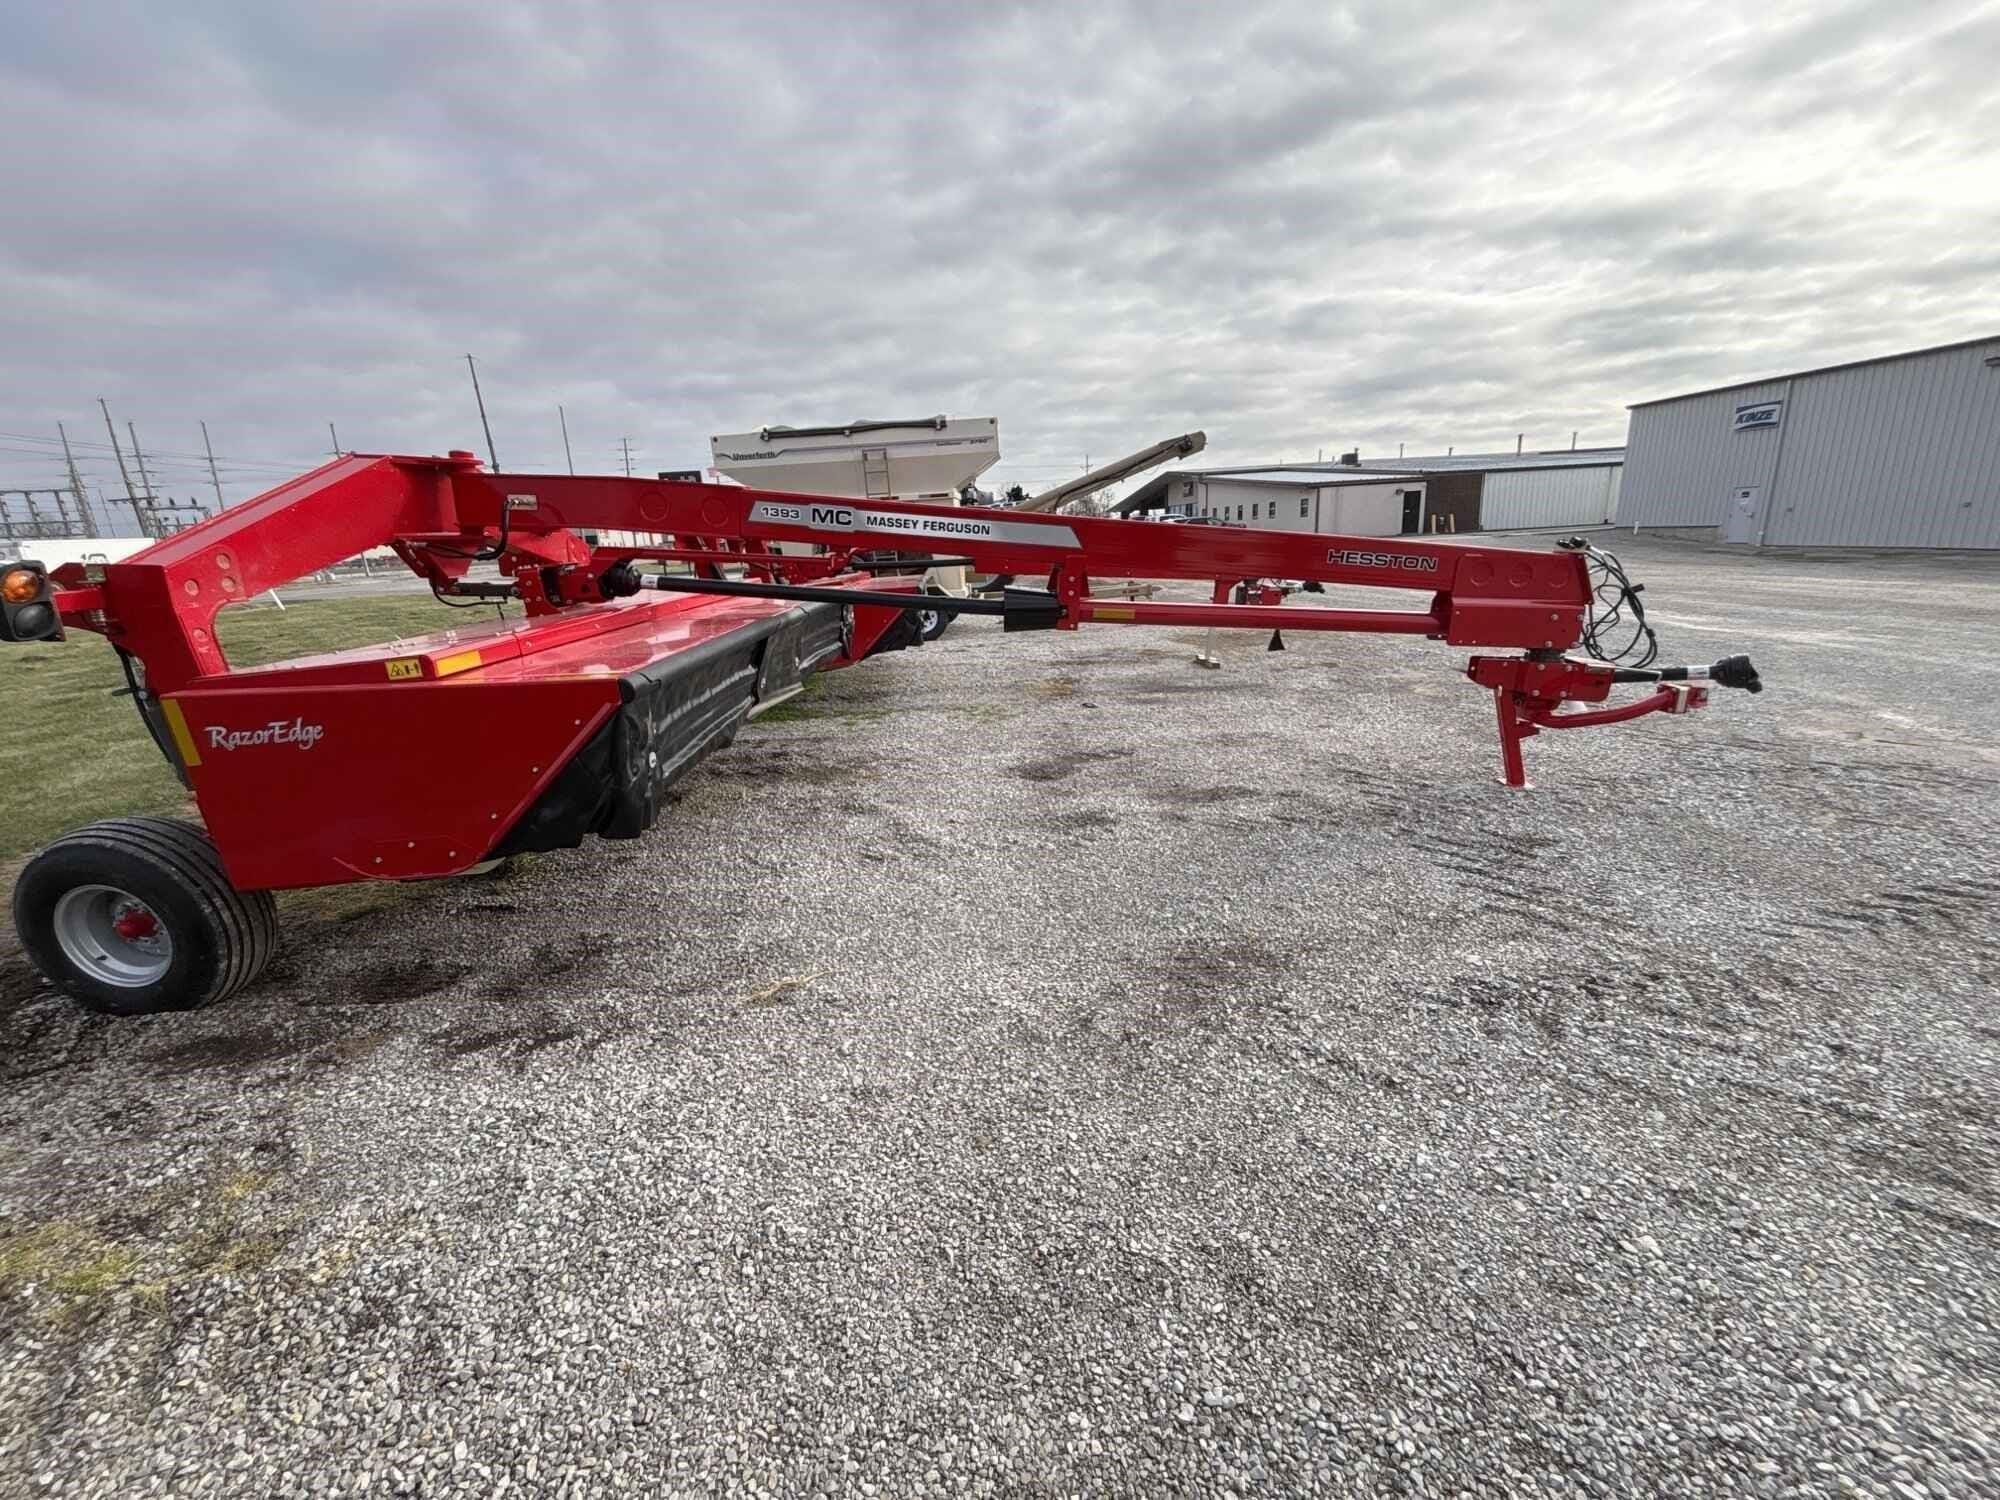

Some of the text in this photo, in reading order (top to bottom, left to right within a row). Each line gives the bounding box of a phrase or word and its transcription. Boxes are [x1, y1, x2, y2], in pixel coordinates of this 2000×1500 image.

[1736, 409, 1776, 424] KINZE
[762, 507, 852, 525] 1393 MC
[866, 515, 991, 535] MASSEY FERGUSON
[1327, 549, 1438, 571] HESSTON
[204, 717, 324, 751] RazorEdge
